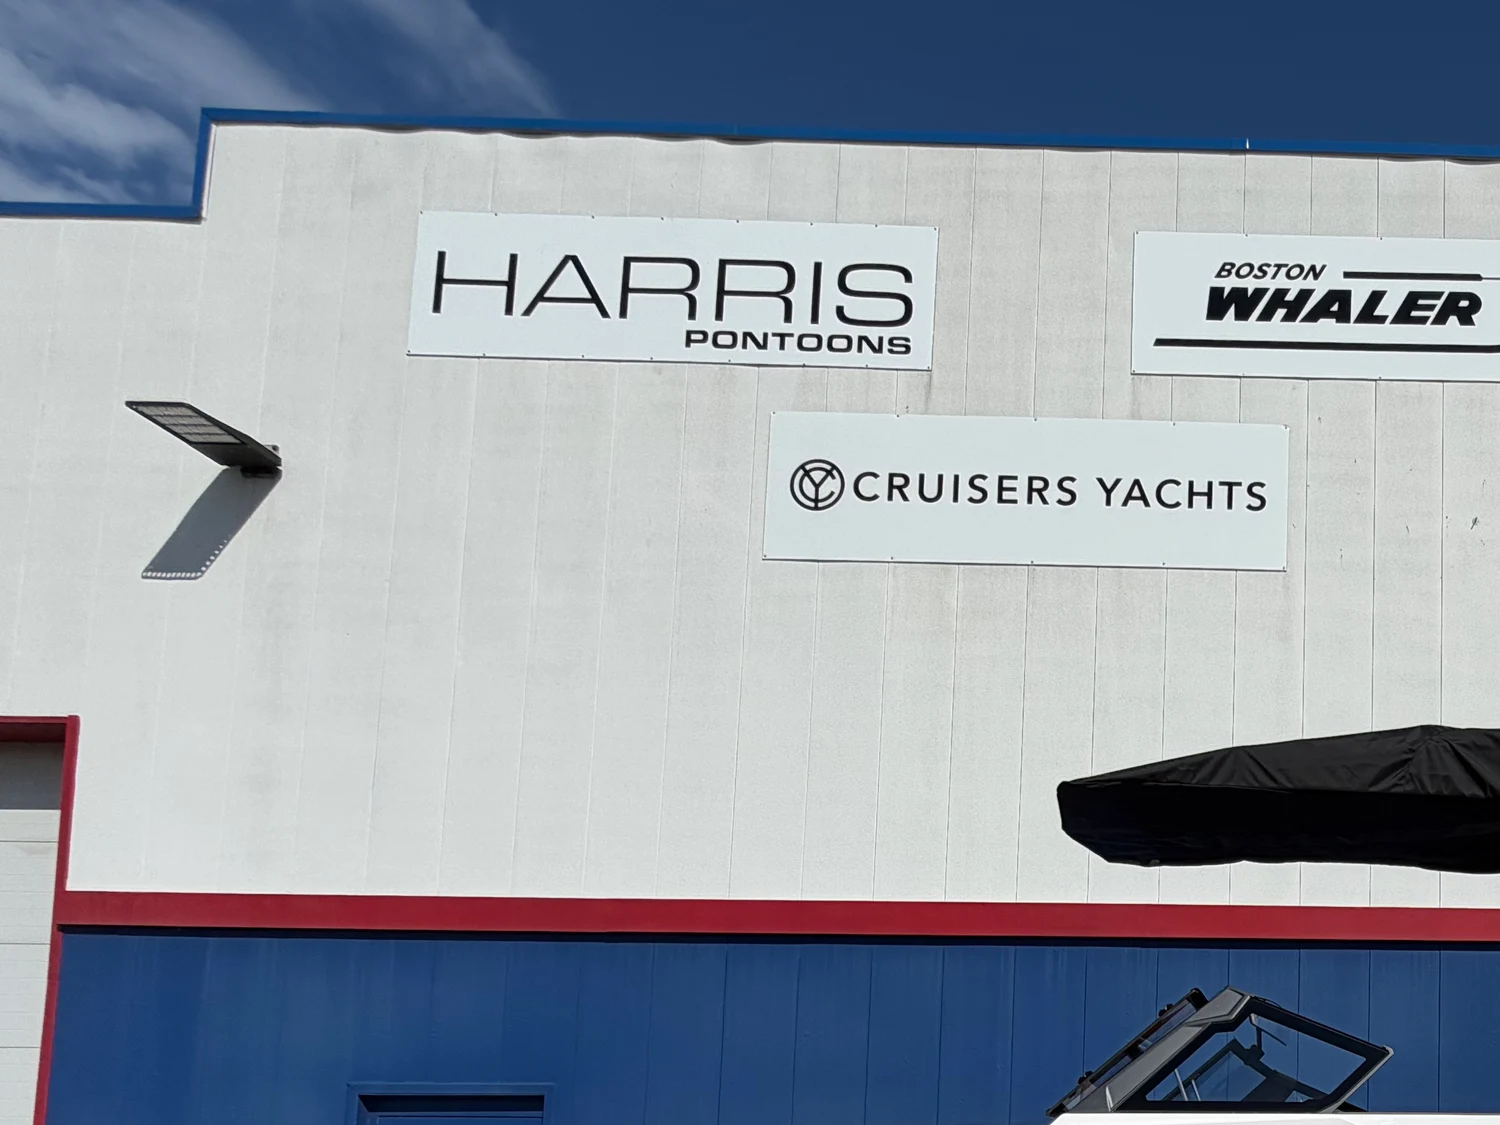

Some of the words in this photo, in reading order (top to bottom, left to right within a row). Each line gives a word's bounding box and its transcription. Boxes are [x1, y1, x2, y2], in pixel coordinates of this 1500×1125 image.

[432, 250, 913, 328] HARRIS
[1214, 261, 1327, 281] BOSTON
[1205, 286, 1483, 327] WHALER
[684, 329, 912, 355] PONTOONS
[852, 471, 1077, 507] CRUISERS
[1095, 477, 1267, 512] YACHTS
